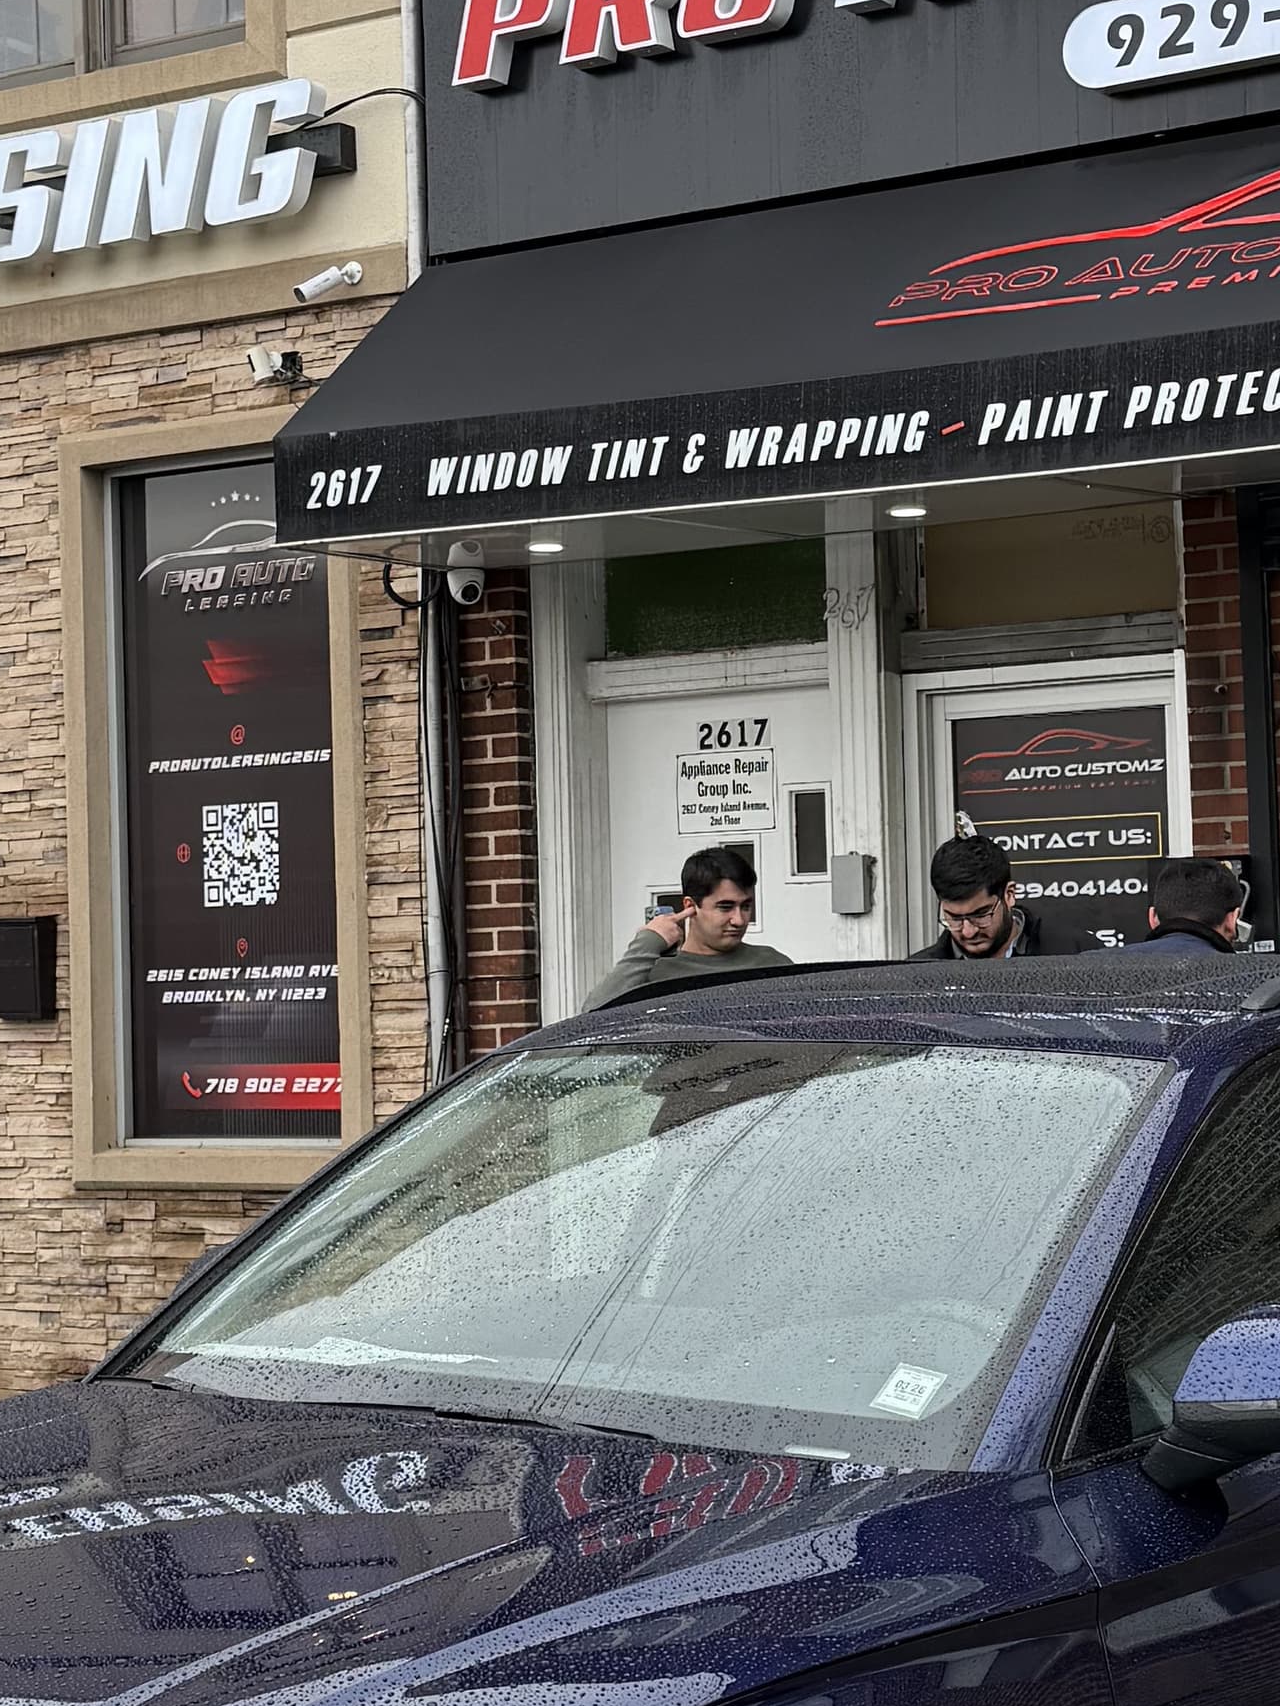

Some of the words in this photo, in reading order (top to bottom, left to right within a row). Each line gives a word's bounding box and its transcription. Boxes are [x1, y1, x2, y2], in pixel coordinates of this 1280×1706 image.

[890, 264, 1058, 308] PRO
[426, 441, 573, 497] WINDOW
[589, 433, 668, 484] TINT
[681, 429, 706, 471] &
[723, 409, 931, 471] WRAPPING
[976, 389, 1107, 447] PAINT
[306, 464, 383, 511] 2617
[160, 564, 225, 596] PRO
[229, 555, 316, 591] AUTO
[184, 588, 293, 613] LEASING
[698, 718, 769, 750] 2617
[148, 749, 331, 773] PROAUTOLEASING2615
[680, 760, 731, 780] Appliance
[734, 756, 769, 776] Repair
[1004, 766, 1062, 781] AUTO
[1064, 758, 1165, 777] CUSTOMZ
[697, 781, 729, 799] Group
[732, 779, 752, 795] Inc.
[698, 803, 719, 814] Coney
[720, 801, 741, 812] Island
[724, 814, 741, 825] Floor
[989, 831, 1101, 851] ONTACT
[1108, 828, 1152, 845] US:
[1014, 878, 1148, 899] 29404140
[146, 968, 185, 982] 2615
[188, 967, 241, 981] CONEY
[244, 965, 305, 980] ISLAND
[308, 964, 339, 977] AVE
[162, 989, 251, 1004] BROOKLYN,
[255, 988, 278, 1001] NY
[281, 987, 327, 1001] 11223
[205, 1077, 240, 1094] 718
[244, 1077, 287, 1093] 902
